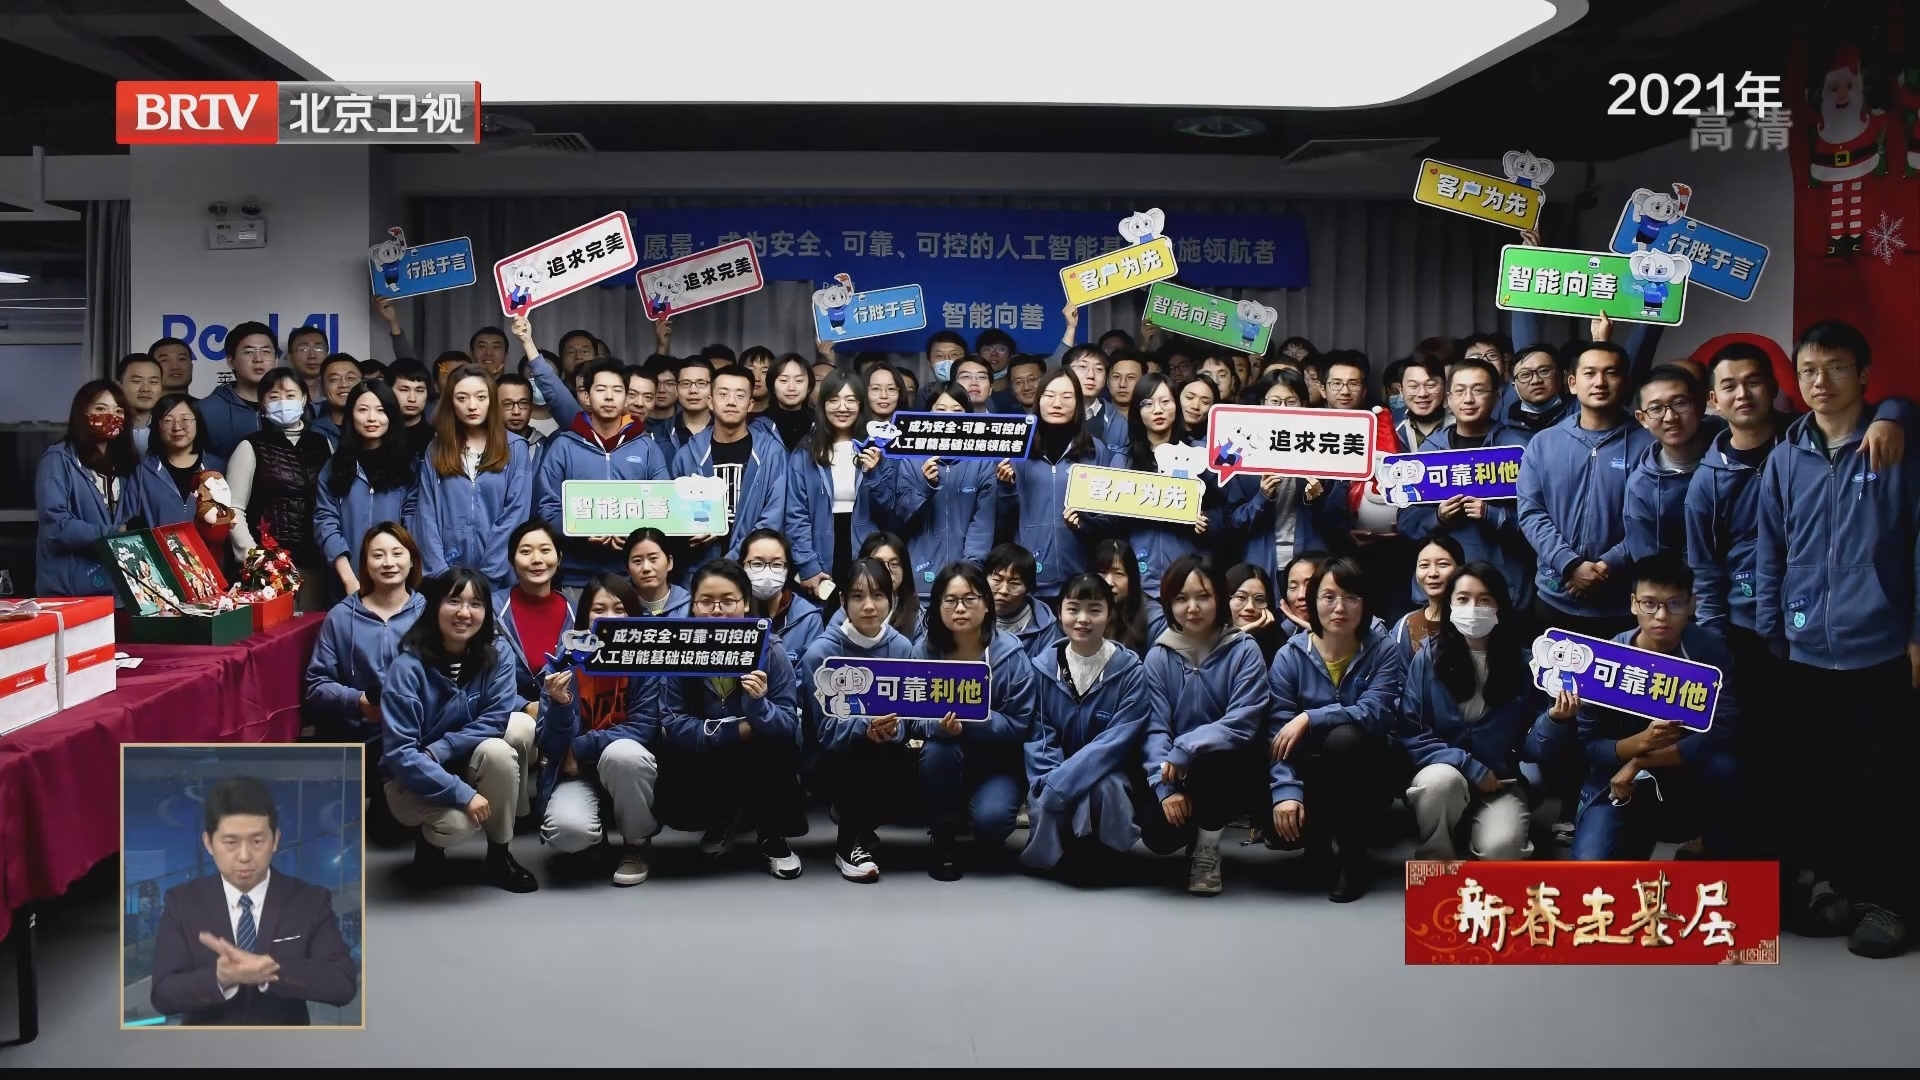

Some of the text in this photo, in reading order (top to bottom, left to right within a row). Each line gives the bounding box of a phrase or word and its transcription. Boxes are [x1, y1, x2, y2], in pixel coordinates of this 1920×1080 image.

[1436, 173, 1528, 217] 客户为先
[406, 252, 467, 281] 行胜于言
[546, 231, 625, 279] 追求完美
[1079, 248, 1164, 293] 客户为先
[1667, 232, 1756, 282] 行胜于言
[683, 256, 754, 293] 追求完美
[1507, 264, 1618, 300] 智能向善
[853, 299, 917, 325] 行胜于言
[942, 301, 1045, 330] 智能向善
[1152, 294, 1227, 331] 智能向善
[890, 435, 1024, 454] 人工智能基础设施领航者
[1269, 429, 1366, 457] 追求完美
[1426, 460, 1519, 488] 可靠利他
[573, 496, 671, 521] 智能向善
[1089, 478, 1188, 510] 客户为先
[591, 647, 755, 667] 人工智能基础设施领航者
[875, 675, 983, 706] 可靠利他
[1593, 657, 1709, 712] 可靠利他
